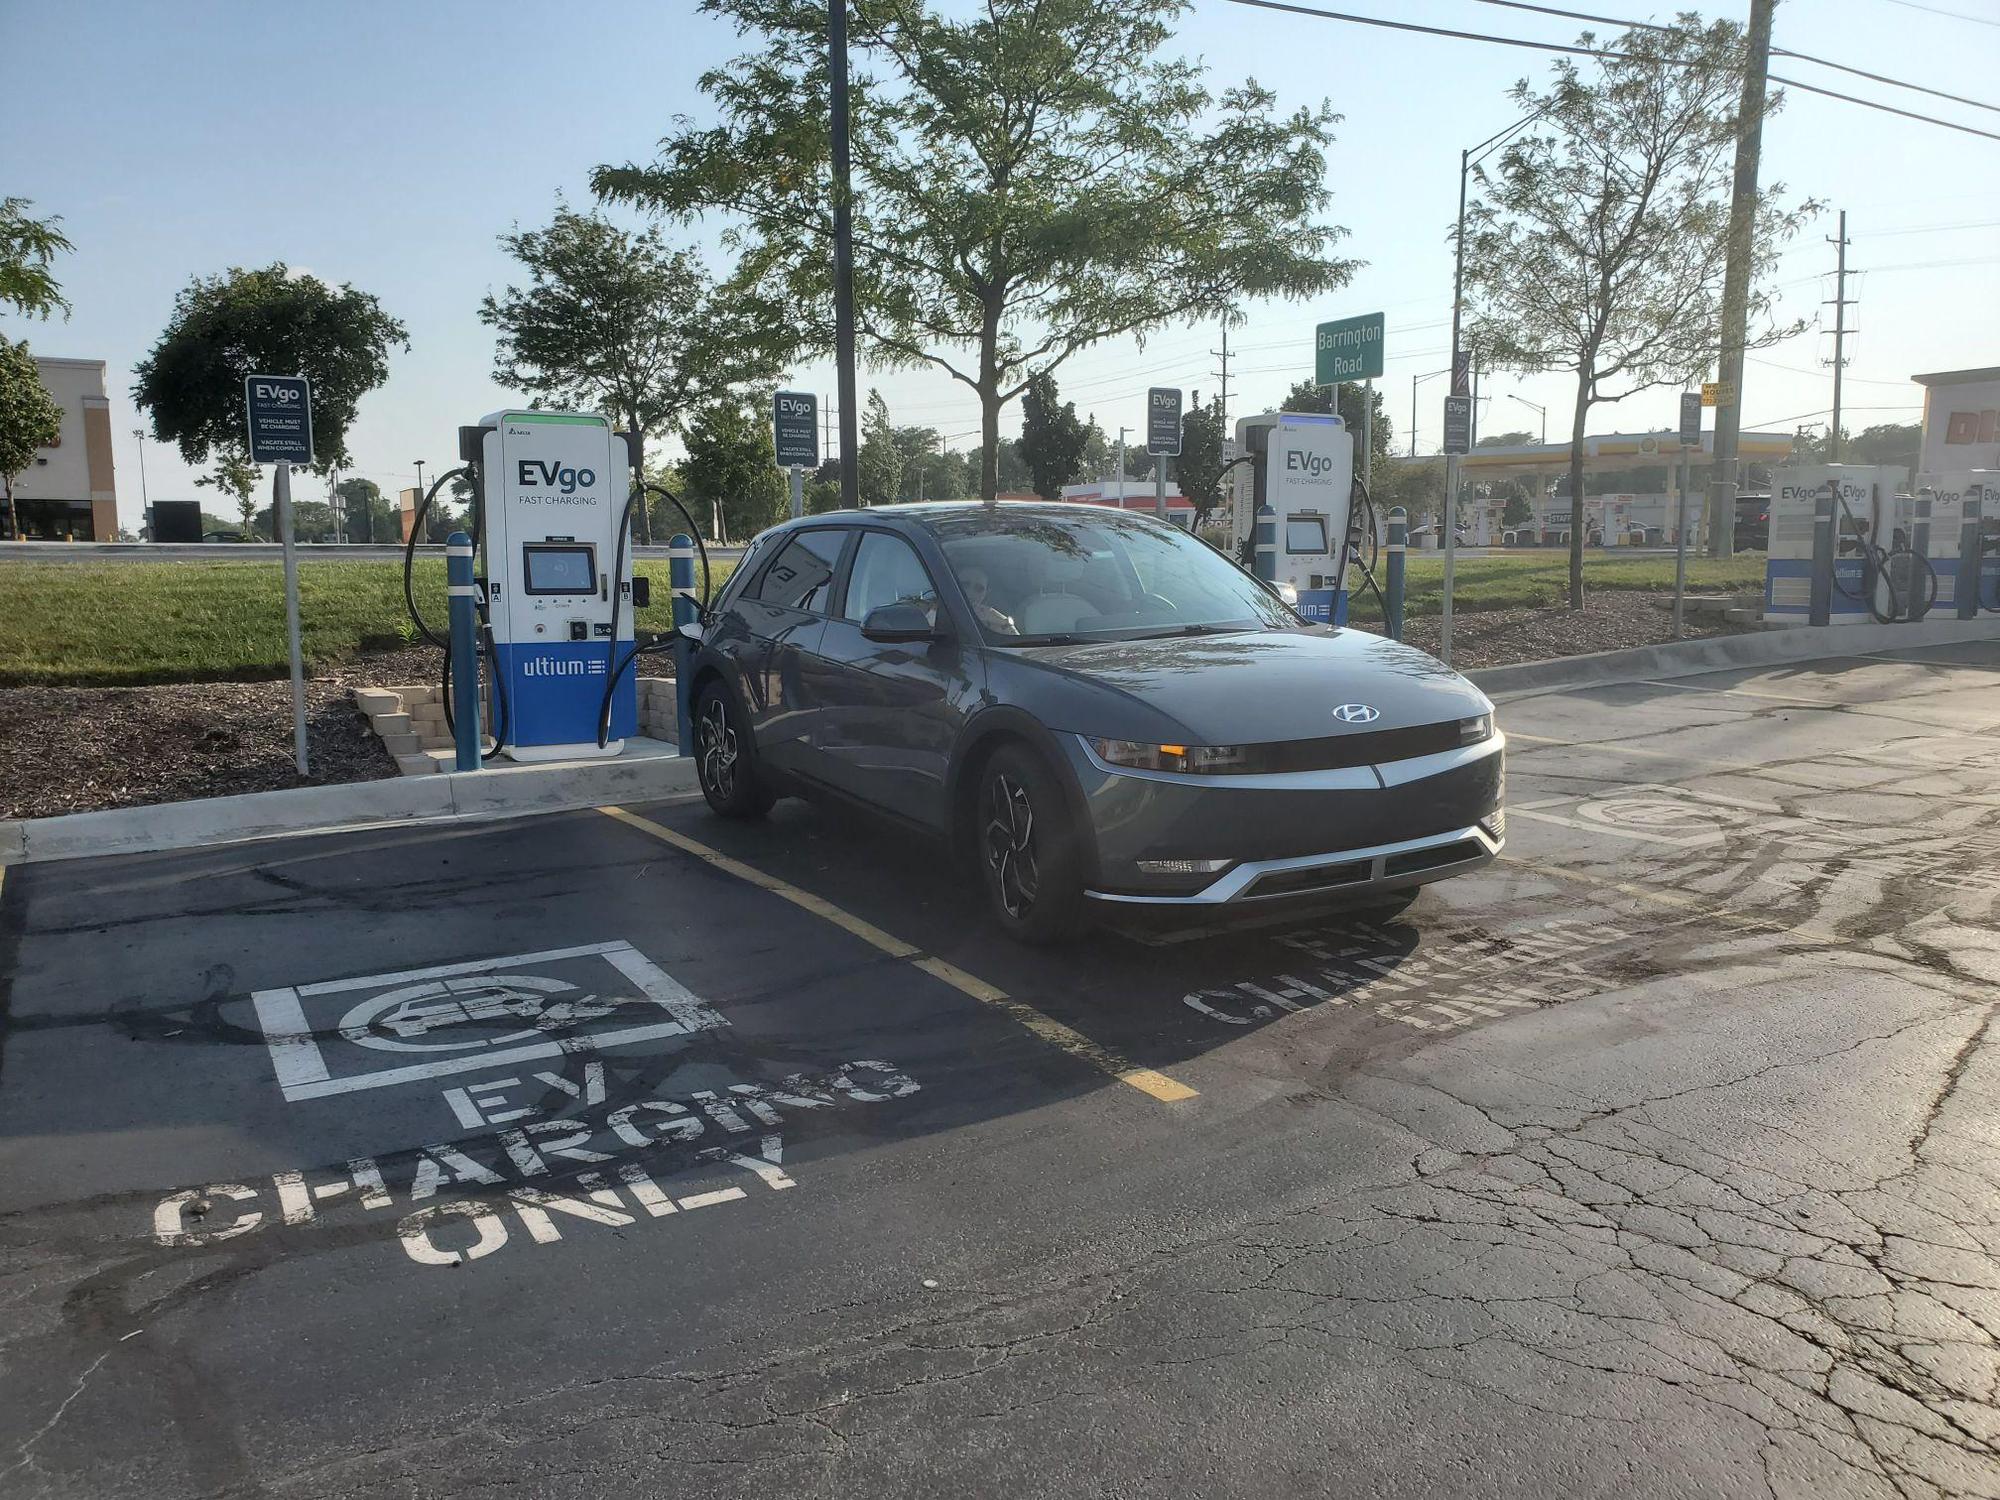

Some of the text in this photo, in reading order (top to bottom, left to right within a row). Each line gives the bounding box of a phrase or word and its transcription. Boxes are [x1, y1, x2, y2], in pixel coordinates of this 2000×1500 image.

[1318, 324, 1381, 350] Barrington
[1334, 354, 1363, 376] Road
[256, 384, 300, 403] EVgo
[1153, 394, 1177, 408] EVgo
[780, 399, 811, 416] EVgo
[1287, 450, 1332, 477] EVgo
[518, 460, 596, 494] EVgo
[519, 496, 597, 506] FAST CHARGING
[1782, 486, 1816, 502] EVgo
[1843, 485, 1867, 501] EVgo
[1933, 490, 1960, 505] Vgo
[1984, 489, 2000, 504] EVg
[524, 657, 585, 676] ultium
[441, 1060, 607, 1130] EV
[153, 1059, 923, 1247] CHARGING
[398, 1133, 797, 1266] ONLY
